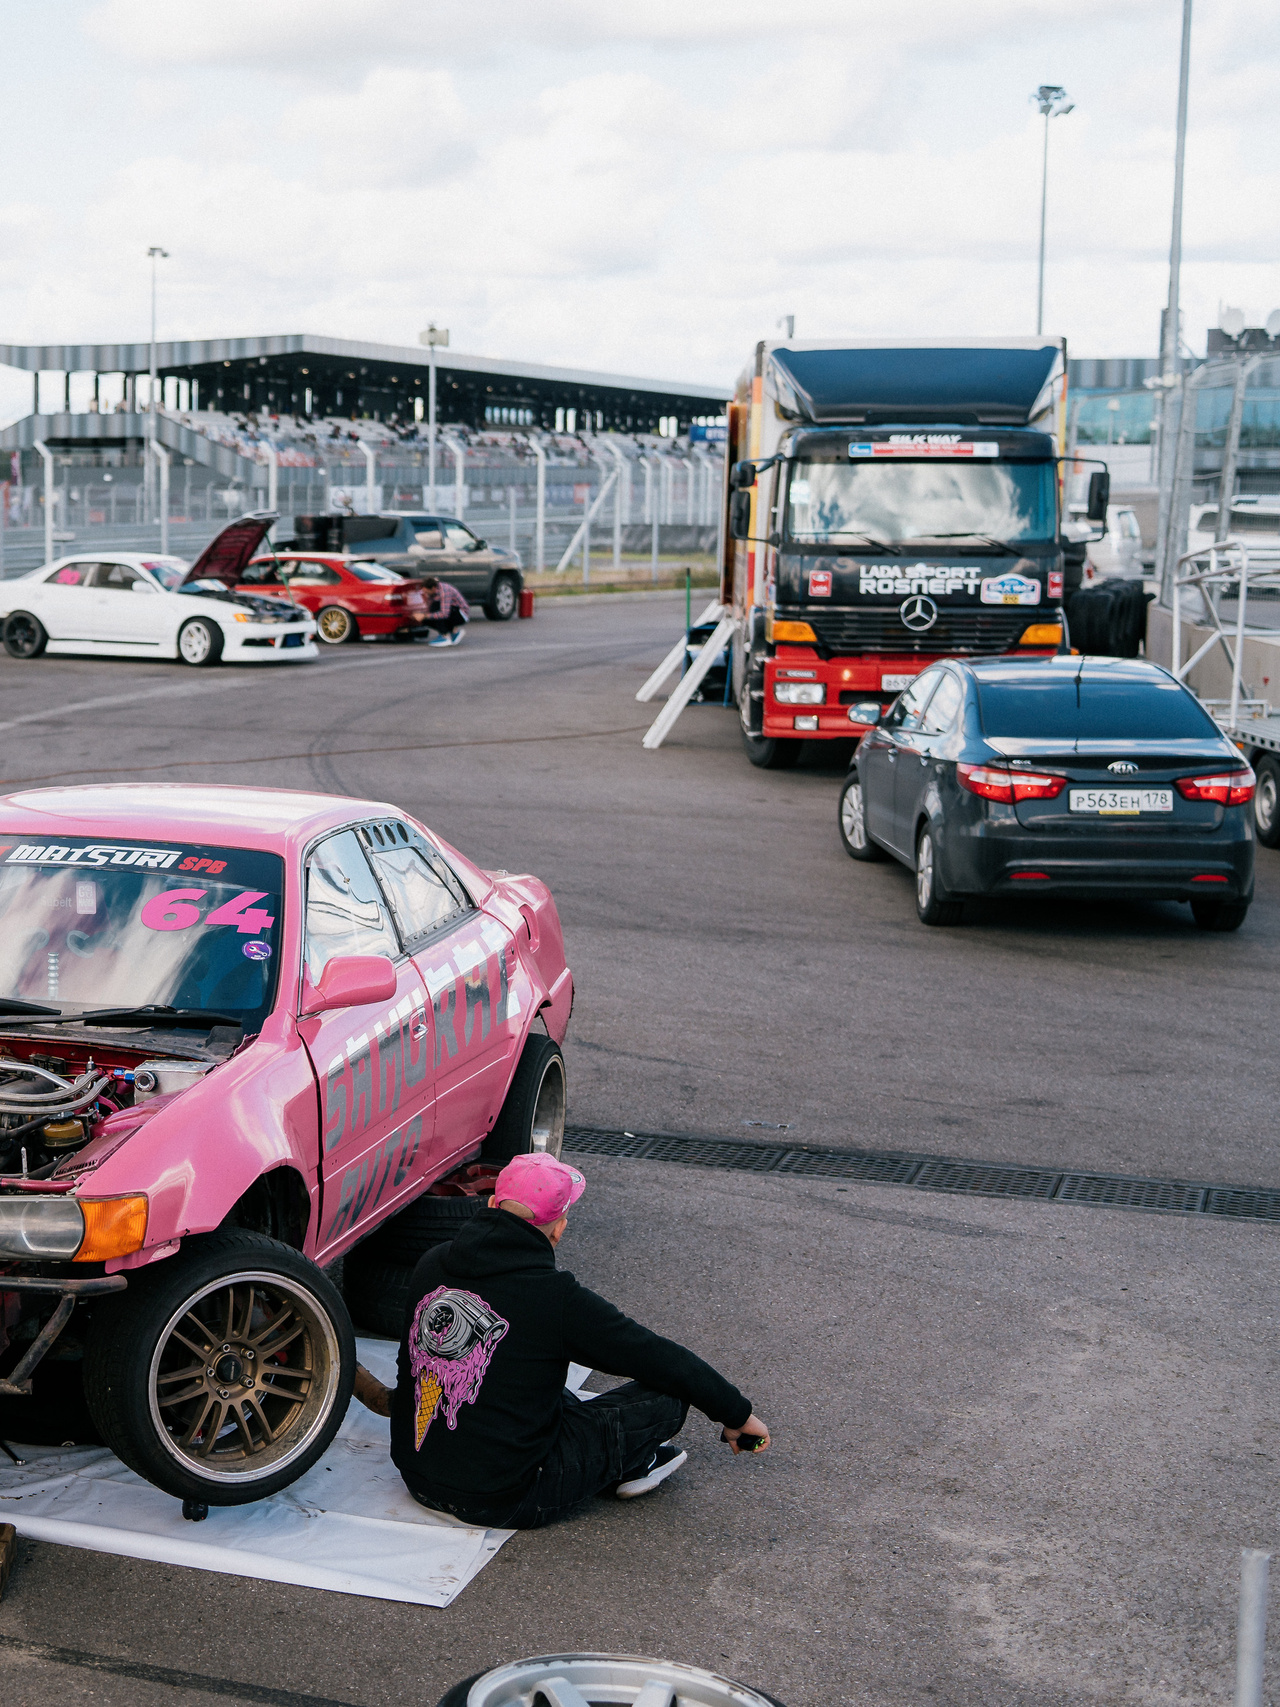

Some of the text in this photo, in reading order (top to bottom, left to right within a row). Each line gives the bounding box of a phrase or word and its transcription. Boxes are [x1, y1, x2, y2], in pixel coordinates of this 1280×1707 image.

[860, 565, 981, 579] LADA SPORT
[859, 579, 981, 595] ROSNEFT
[1144, 792, 1168, 804] 178
[5, 844, 182, 868] MATSURI
[178, 856, 227, 874] SPB
[141, 888, 275, 935] 64
[326, 920, 521, 1153] SAMURAI
